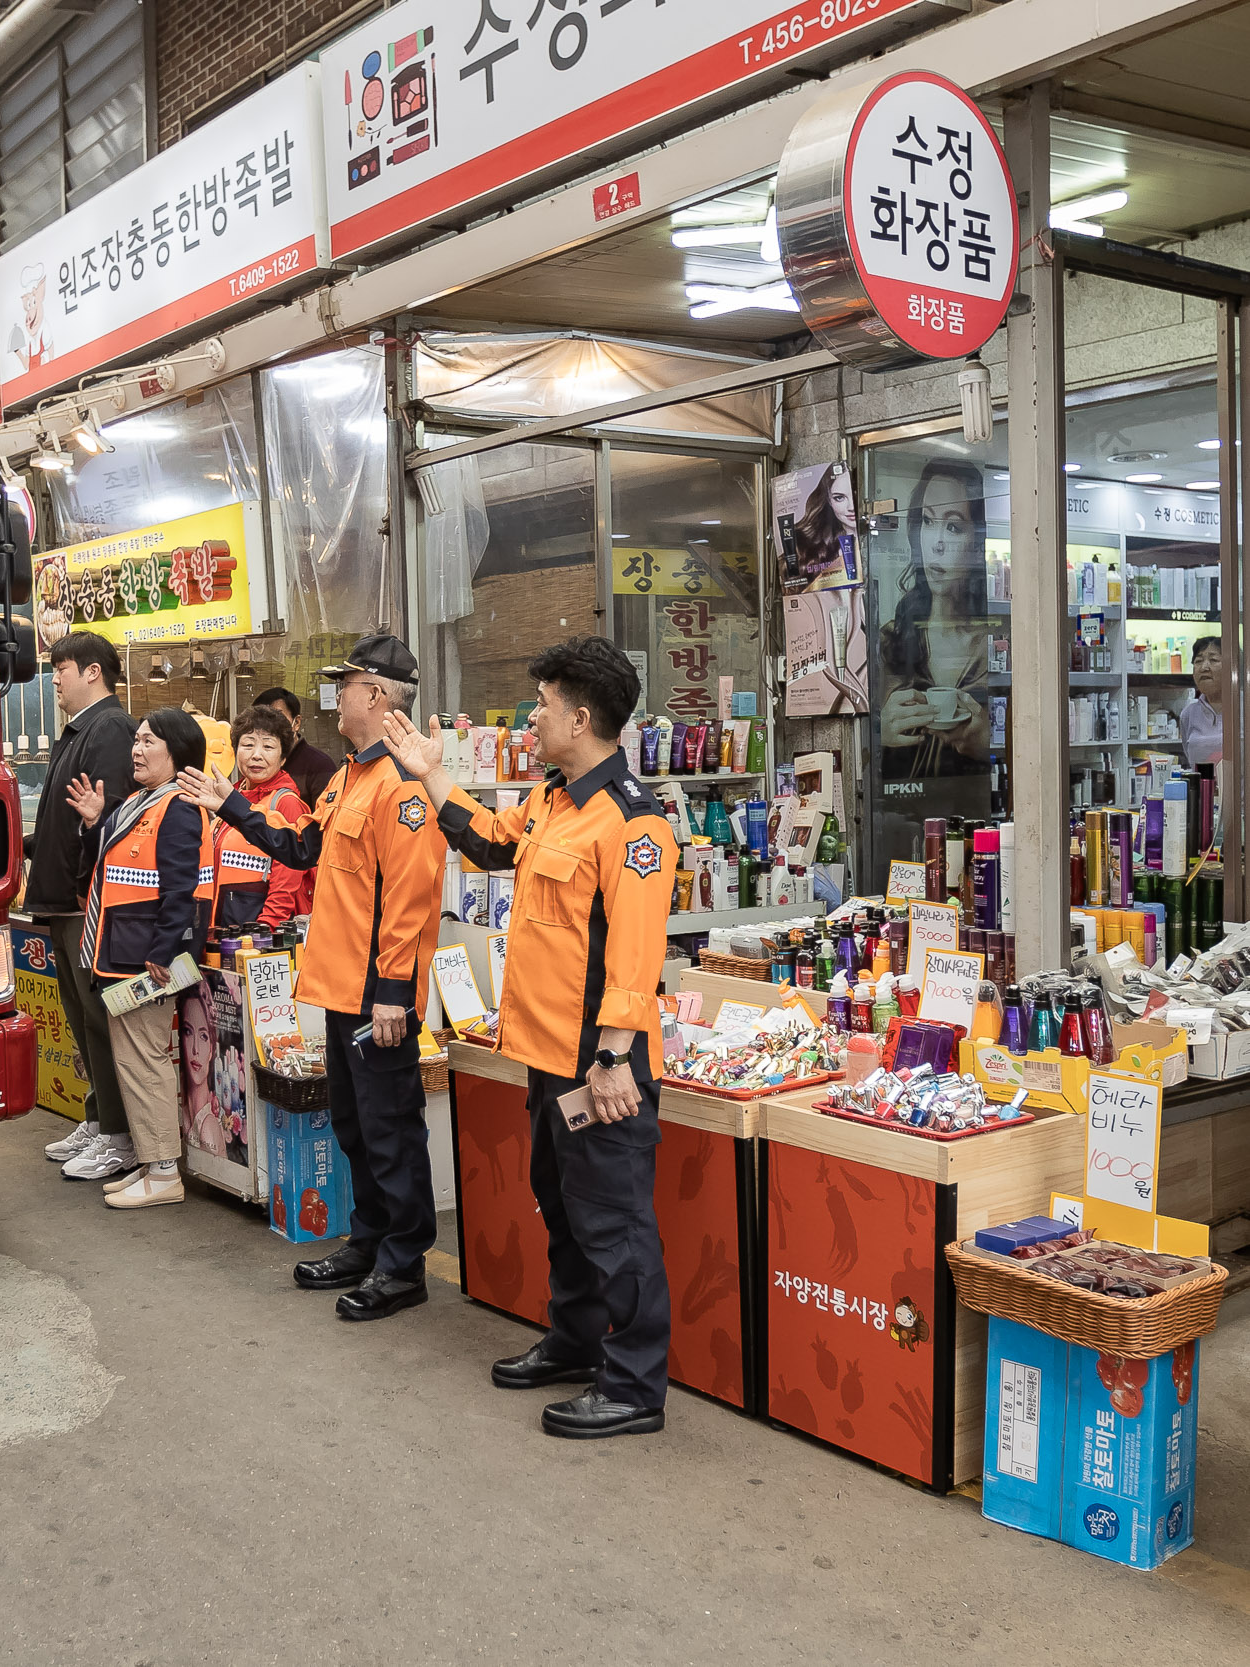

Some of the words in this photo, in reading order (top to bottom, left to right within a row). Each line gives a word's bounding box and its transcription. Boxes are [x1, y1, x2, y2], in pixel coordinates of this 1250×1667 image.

[891, 115, 974, 201] 수정
[608, 183, 619, 206] 2
[58, 130, 295, 315] 원조장충동한방족발
[869, 186, 998, 283] 화장품
[229, 249, 300, 297] T.6409-1522
[907, 293, 966, 336] 화장품
[1154, 507, 1171, 522] 수정
[1174, 509, 1220, 525] COSMETIC
[883, 782, 924, 795] IPKN
[249, 959, 290, 984] 설화수
[255, 983, 281, 1000] 로션
[254, 1004, 297, 1026] 15000
[1092, 1079, 1153, 1109] 헤라
[1092, 1110, 1144, 1136] 비누
[1089, 1148, 1154, 1180] 1000
[1134, 1180, 1152, 1199] 원
[773, 1269, 889, 1332] 자양전통시장
[1092, 1409, 1117, 1489] 찰토마토
[1169, 1408, 1183, 1491] 찰토마토
